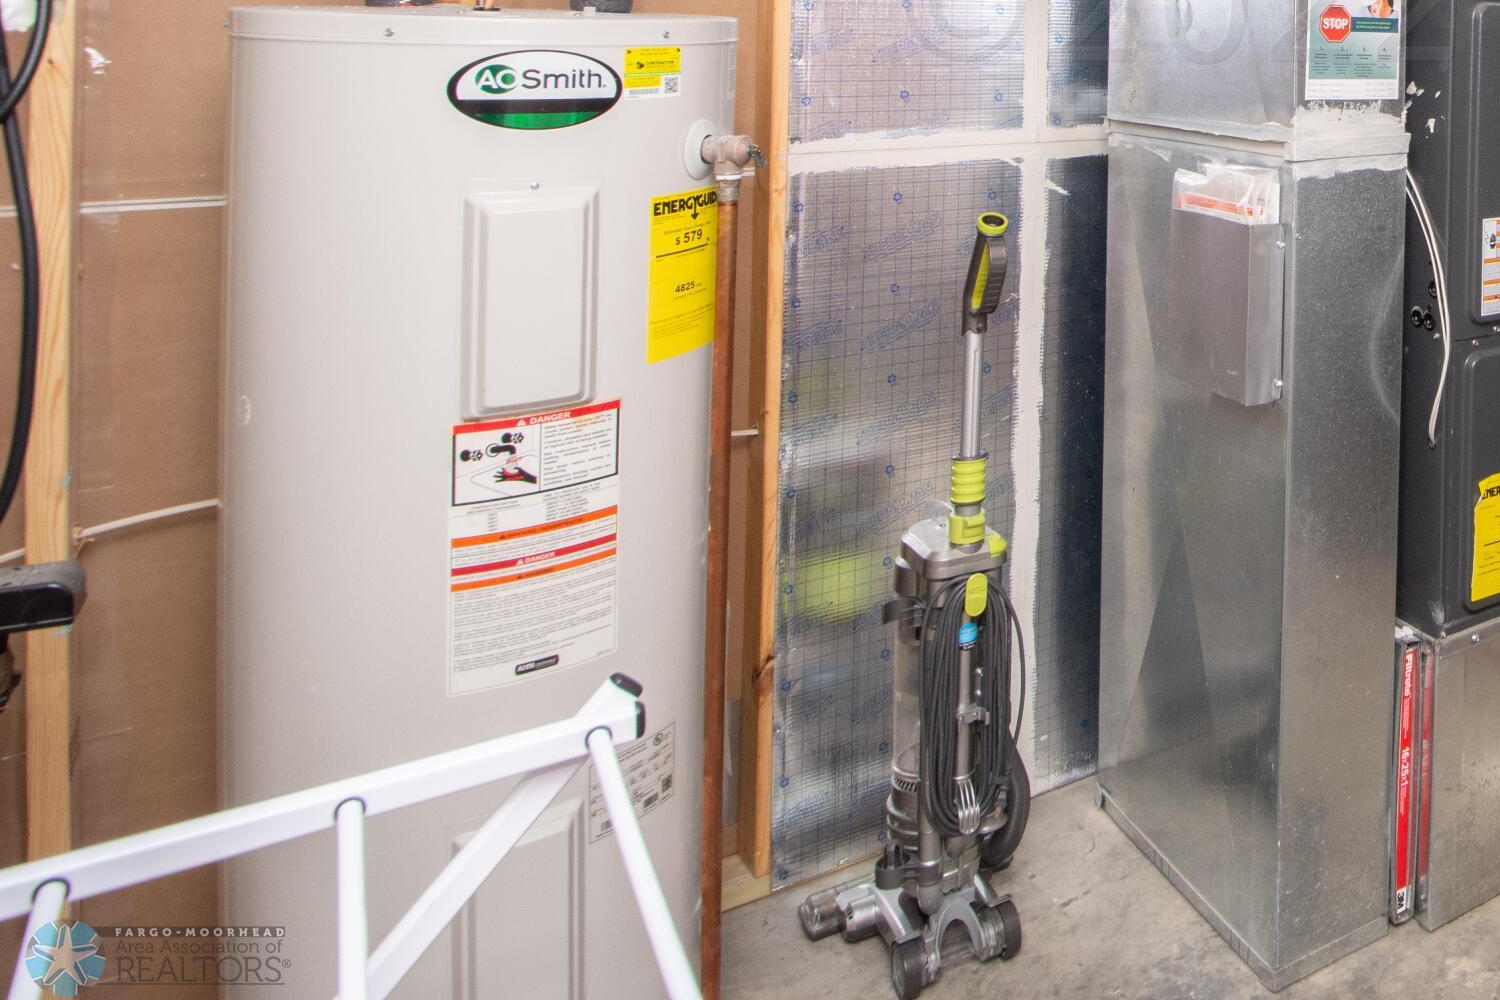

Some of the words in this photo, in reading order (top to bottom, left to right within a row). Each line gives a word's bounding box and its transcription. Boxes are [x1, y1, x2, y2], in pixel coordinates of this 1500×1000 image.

[1322, 17, 1349, 30] STOP
[653, 190, 718, 218] ENERGYGUID
[684, 228, 703, 244] 579
[674, 280, 696, 293] 4825
[529, 410, 571, 425] DANGER
[524, 551, 556, 564] DANGER
[1396, 891, 1405, 910] 3M
